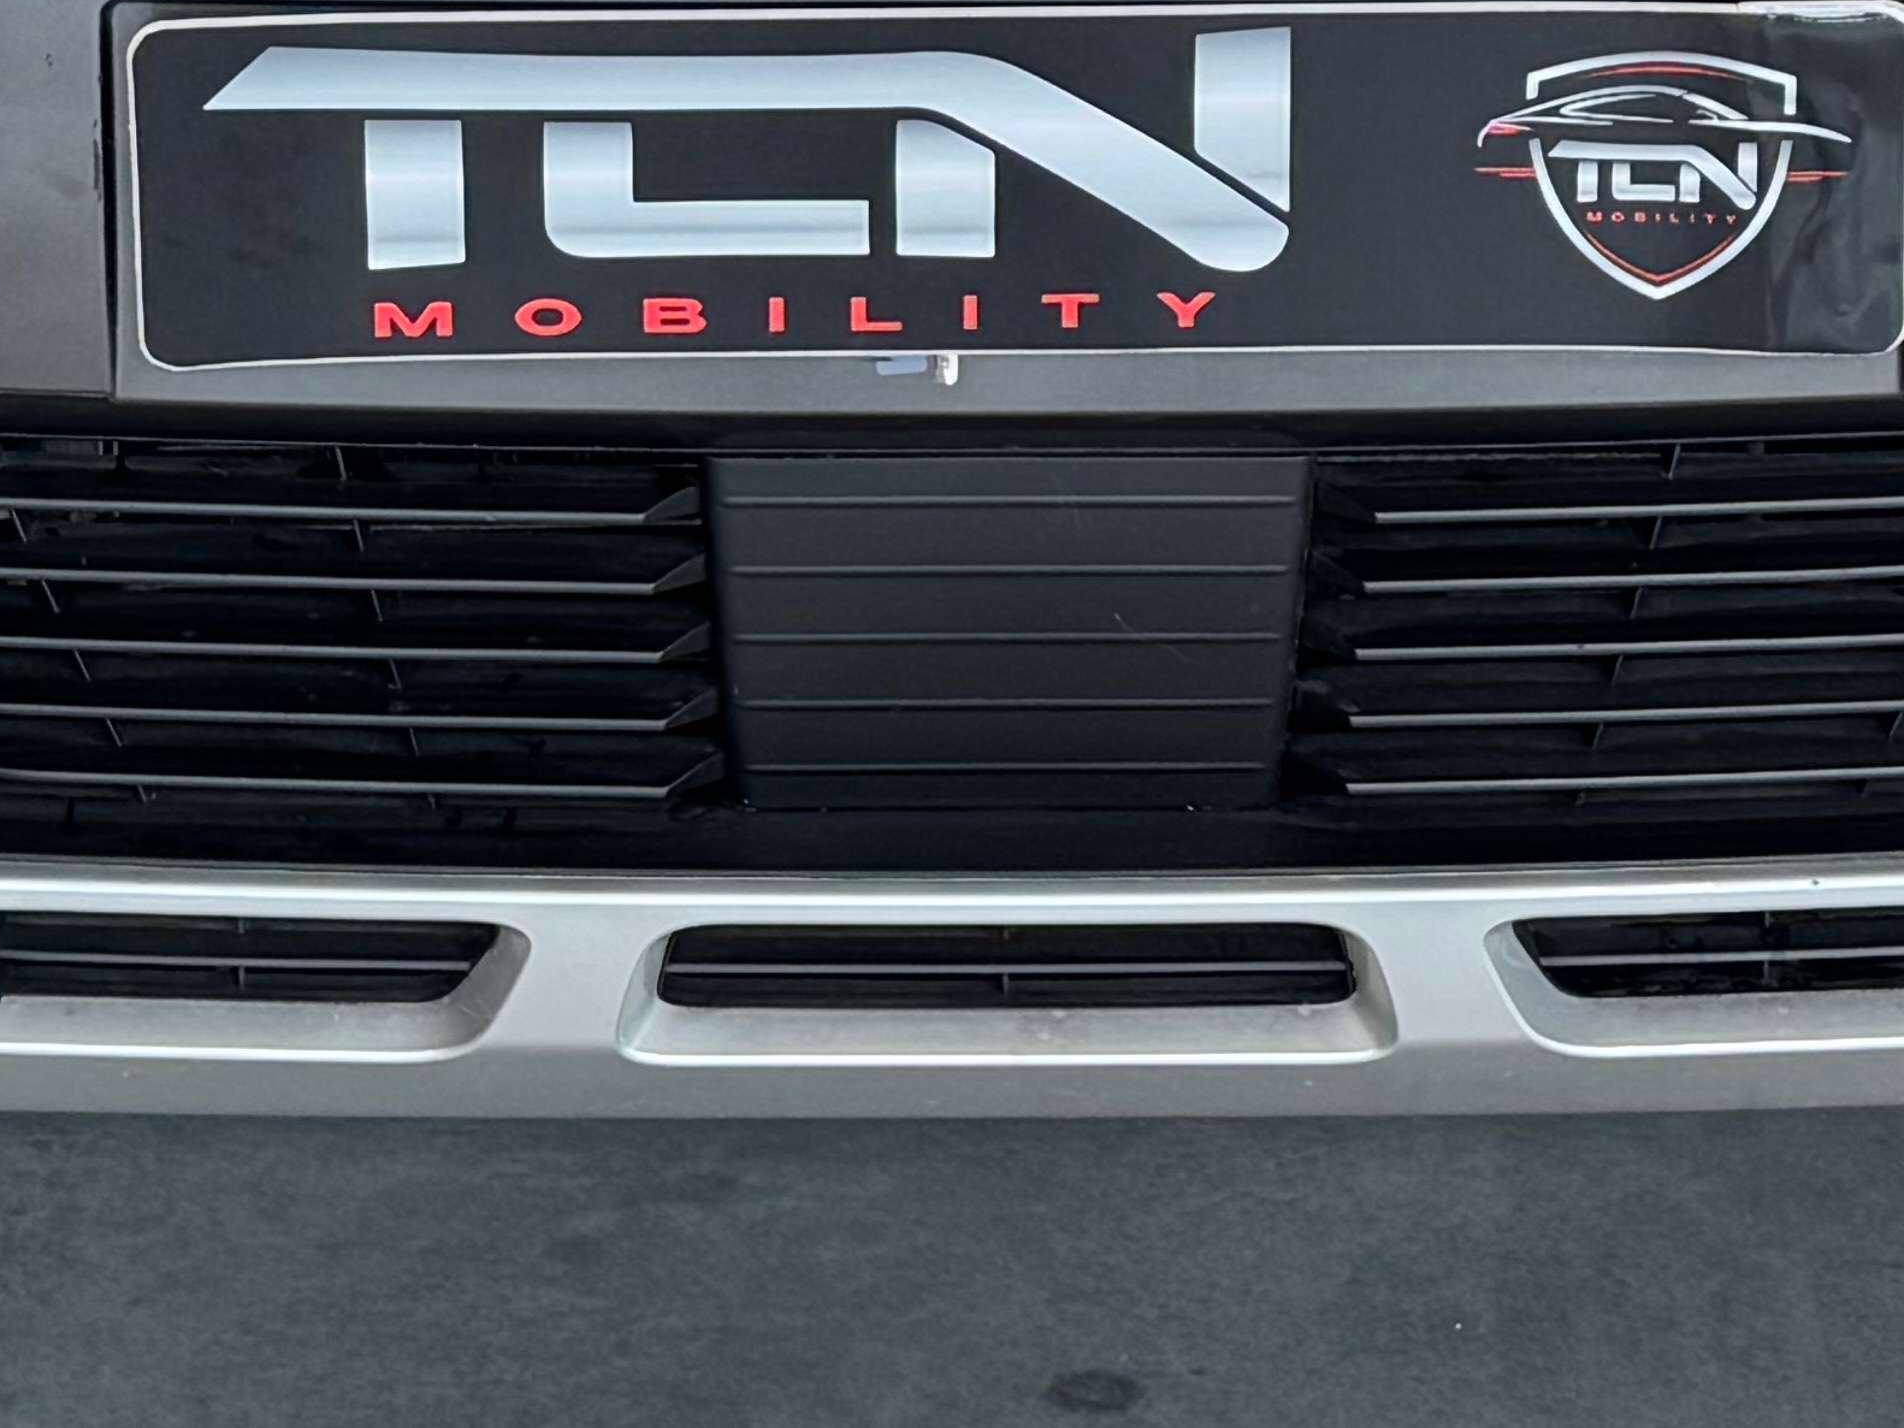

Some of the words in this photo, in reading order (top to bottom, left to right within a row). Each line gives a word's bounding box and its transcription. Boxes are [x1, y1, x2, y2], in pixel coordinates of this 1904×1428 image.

[203, 27, 1291, 271] TCN
[1548, 140, 1757, 209] TCN
[1586, 210, 1737, 224] MOBILITY
[373, 291, 1216, 339] MOBILITY
